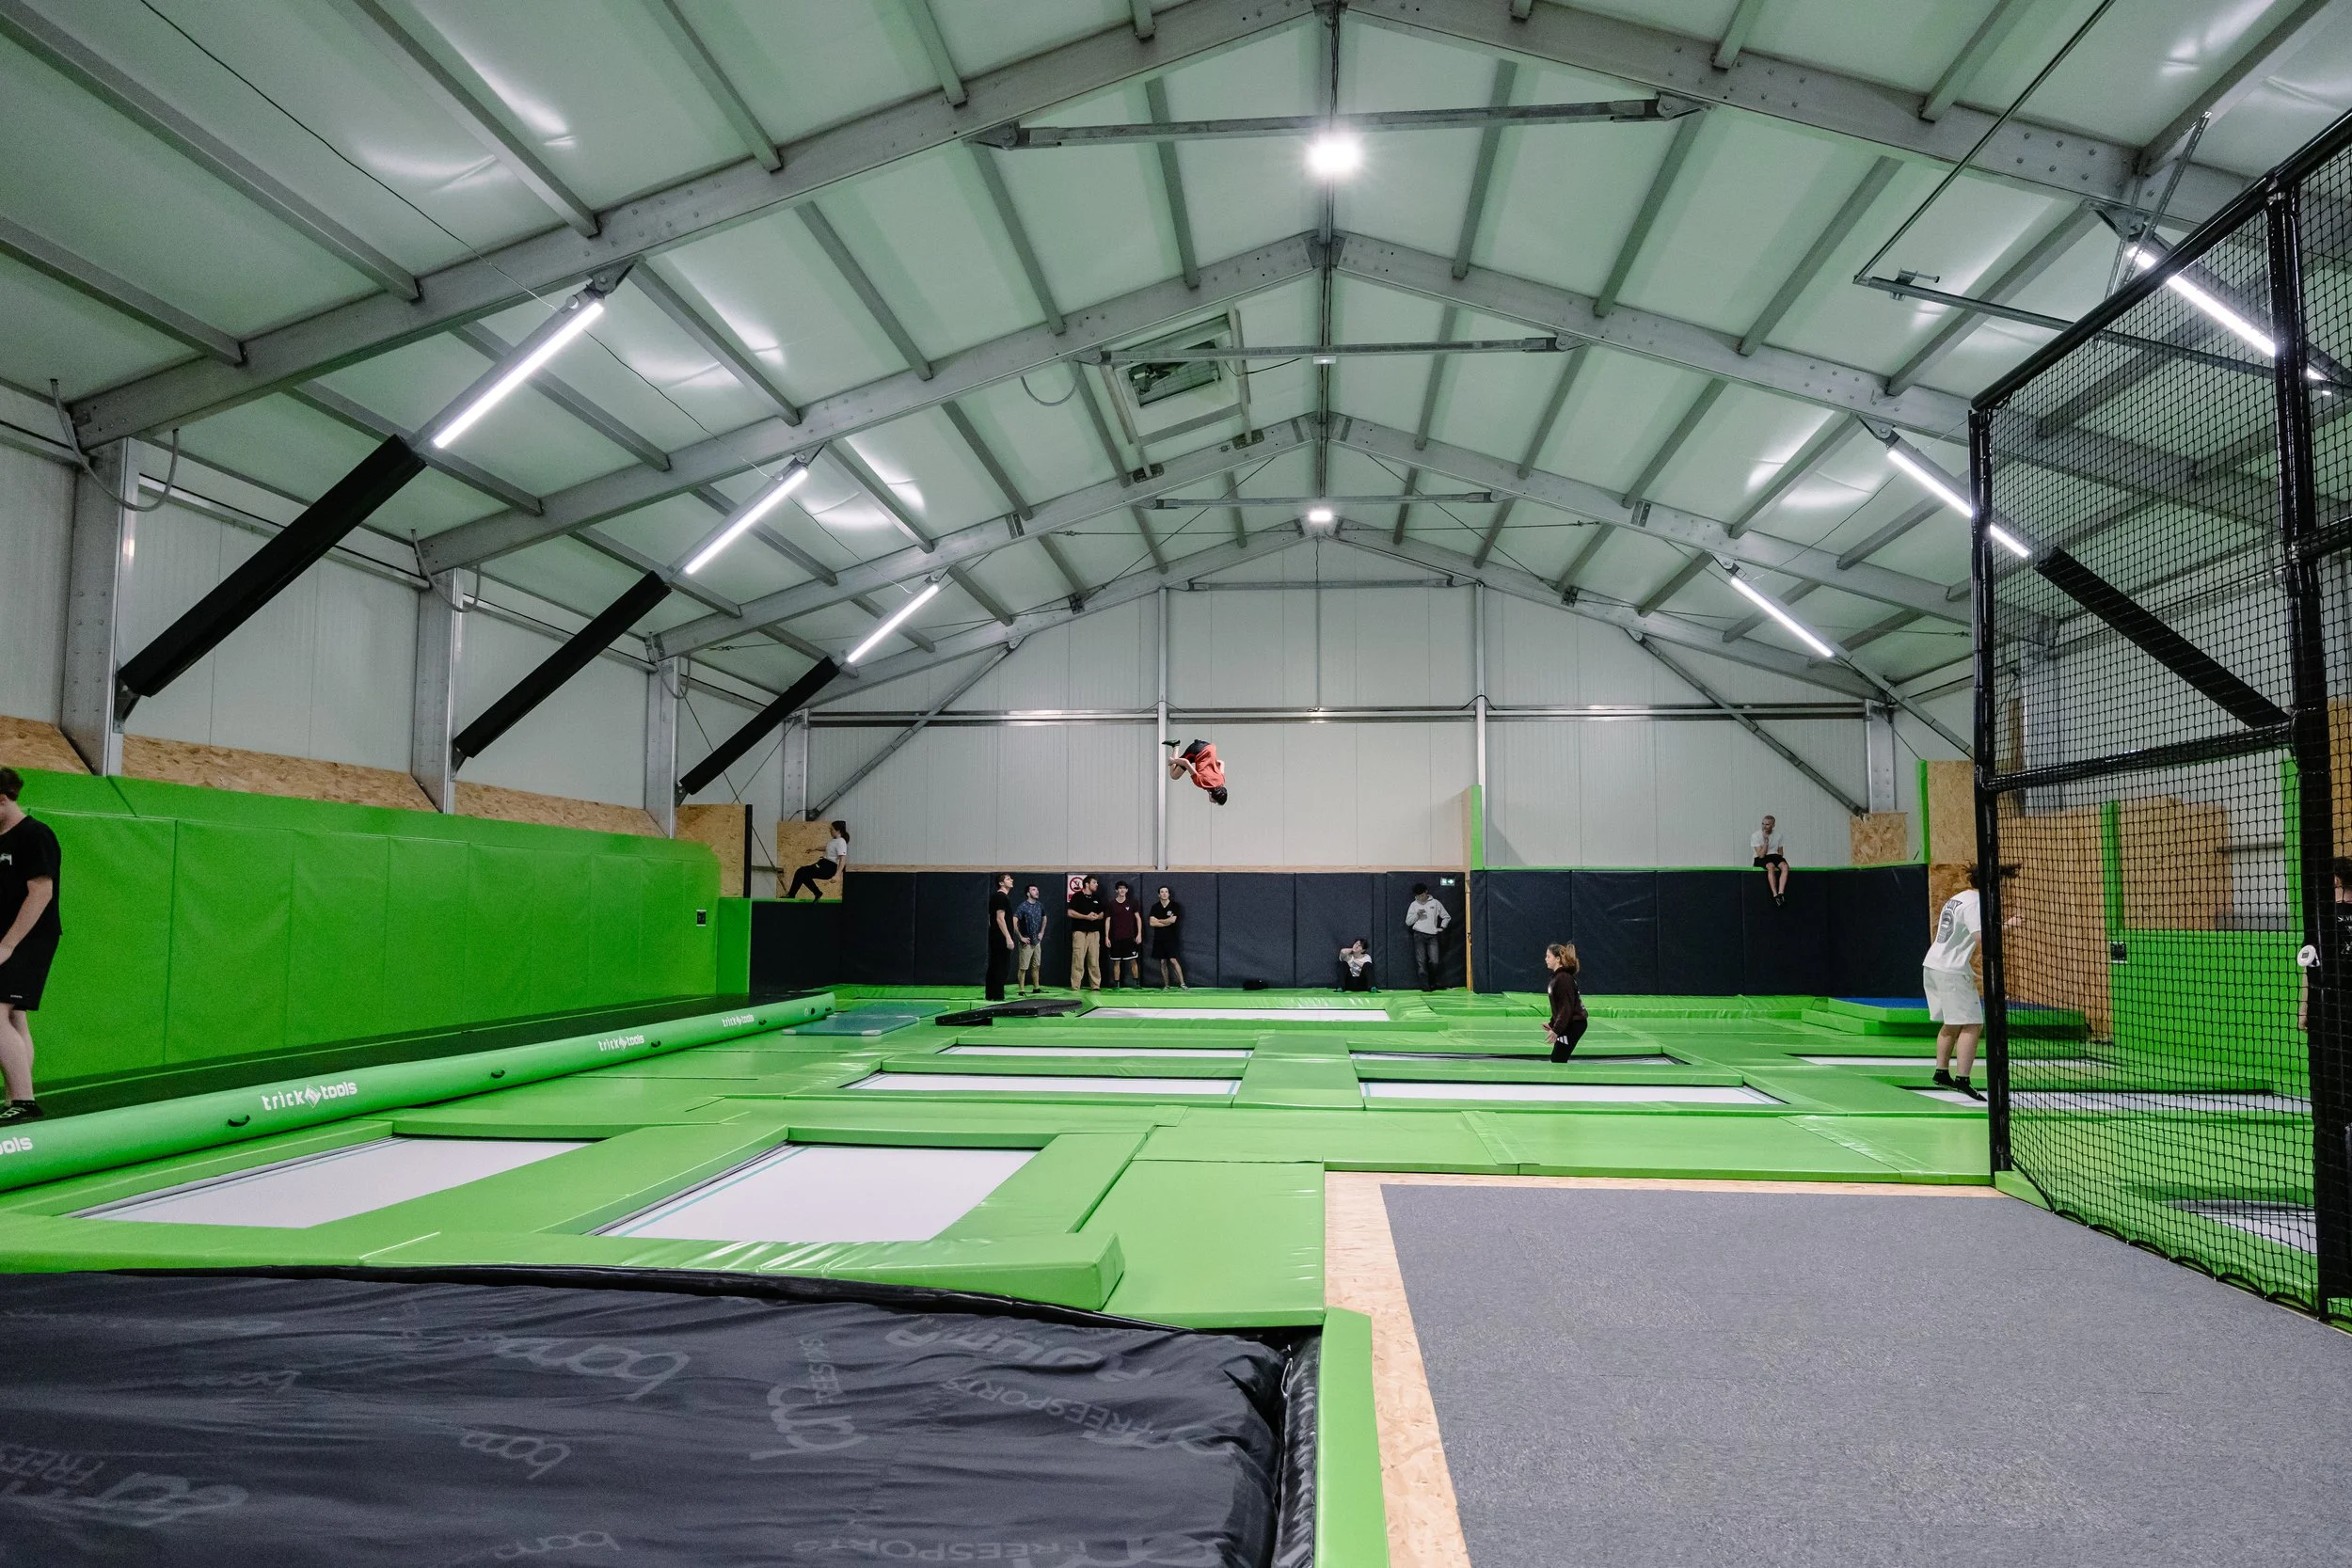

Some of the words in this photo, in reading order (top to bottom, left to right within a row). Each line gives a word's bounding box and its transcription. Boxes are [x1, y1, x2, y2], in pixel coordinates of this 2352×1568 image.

[597, 1037, 620, 1052] trick
[625, 1034, 644, 1046] tools
[261, 1089, 306, 1111] trick
[320, 1081, 358, 1100] tools
[0, 1136, 34, 1155] ols
[940, 1376, 1154, 1437] FREESPORTS
[794, 1539, 1087, 1562] FREESPORTS
